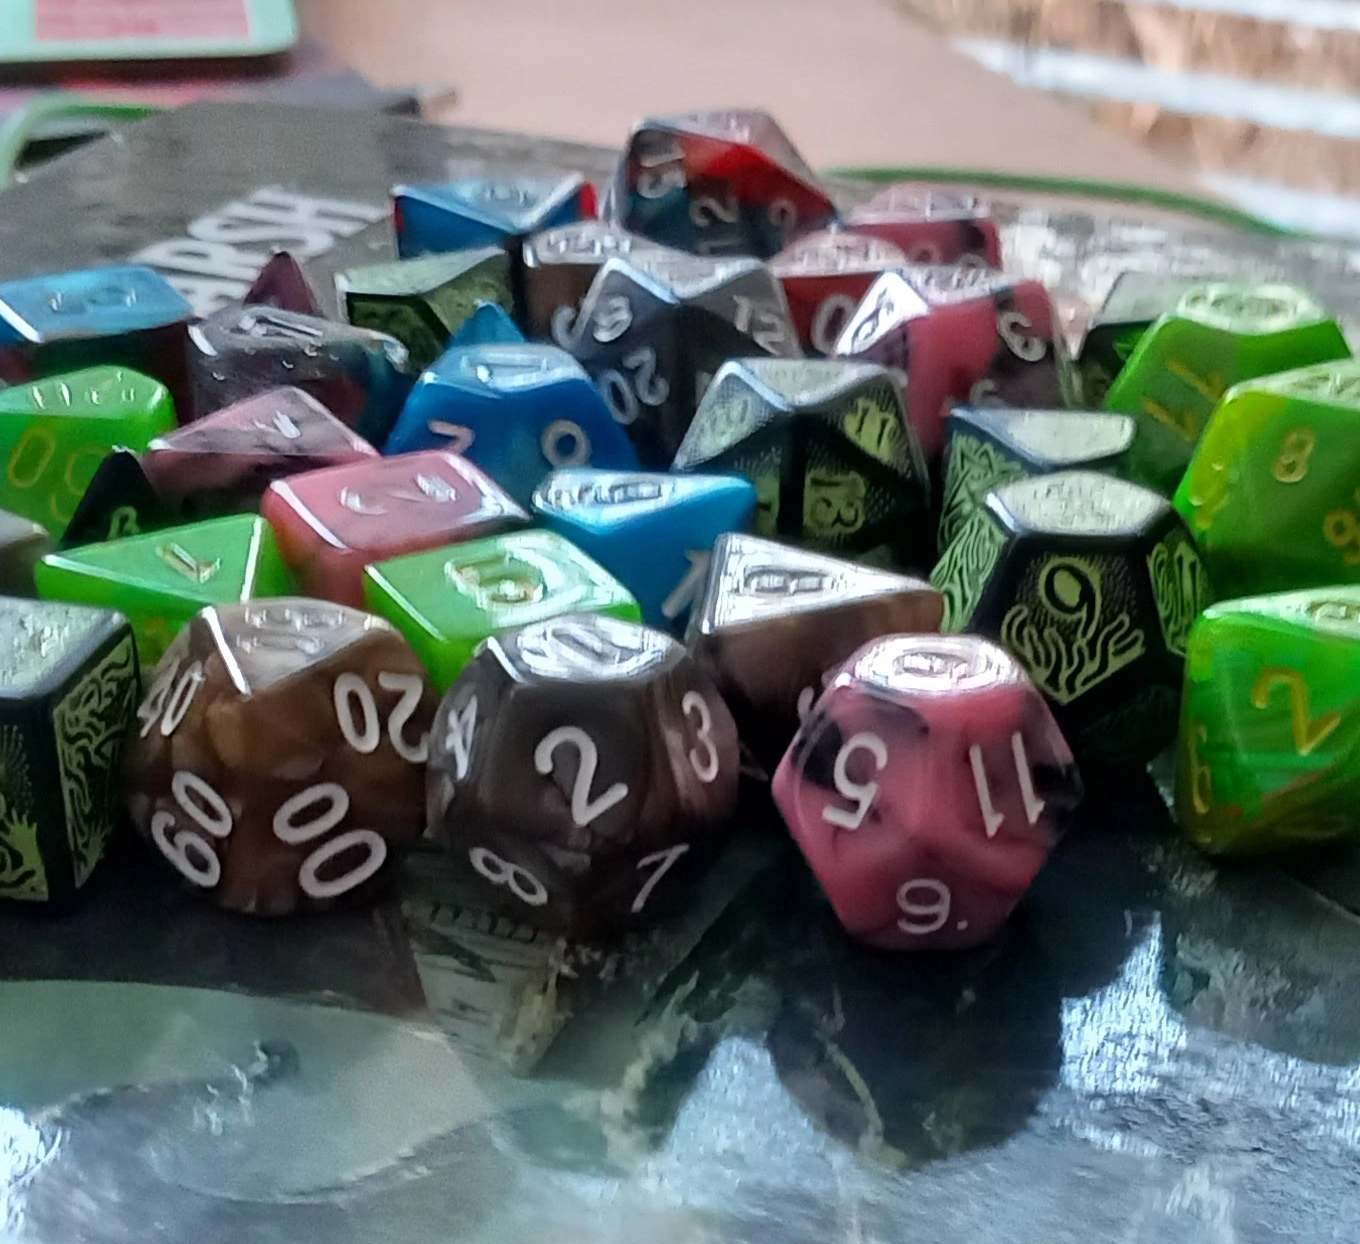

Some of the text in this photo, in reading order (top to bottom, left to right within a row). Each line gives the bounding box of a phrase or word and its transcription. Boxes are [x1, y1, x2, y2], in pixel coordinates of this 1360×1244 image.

[682, 690, 720, 784] 3
[1251, 667, 1341, 757] 2
[534, 725, 629, 828] 2
[822, 731, 888, 830] 5
[968, 731, 1045, 838] 11
[272, 781, 388, 898] 00
[469, 847, 549, 906] 8
